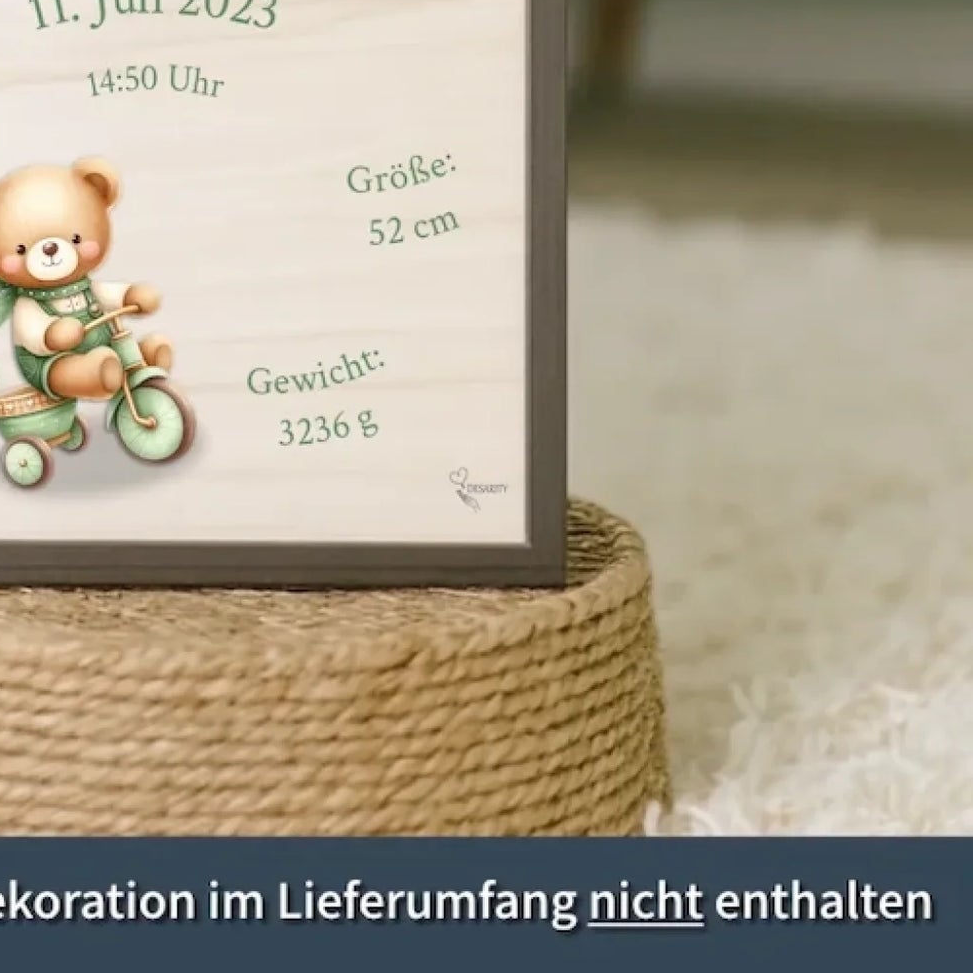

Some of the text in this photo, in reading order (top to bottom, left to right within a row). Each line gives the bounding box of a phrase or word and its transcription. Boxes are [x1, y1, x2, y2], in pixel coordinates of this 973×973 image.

[87, 64, 225, 98] 14:50 Uhr
[347, 153, 457, 193] Größe:
[369, 211, 460, 245] 52 cm
[247, 349, 385, 395] Gewicht:
[278, 409, 379, 447] 3236 g
